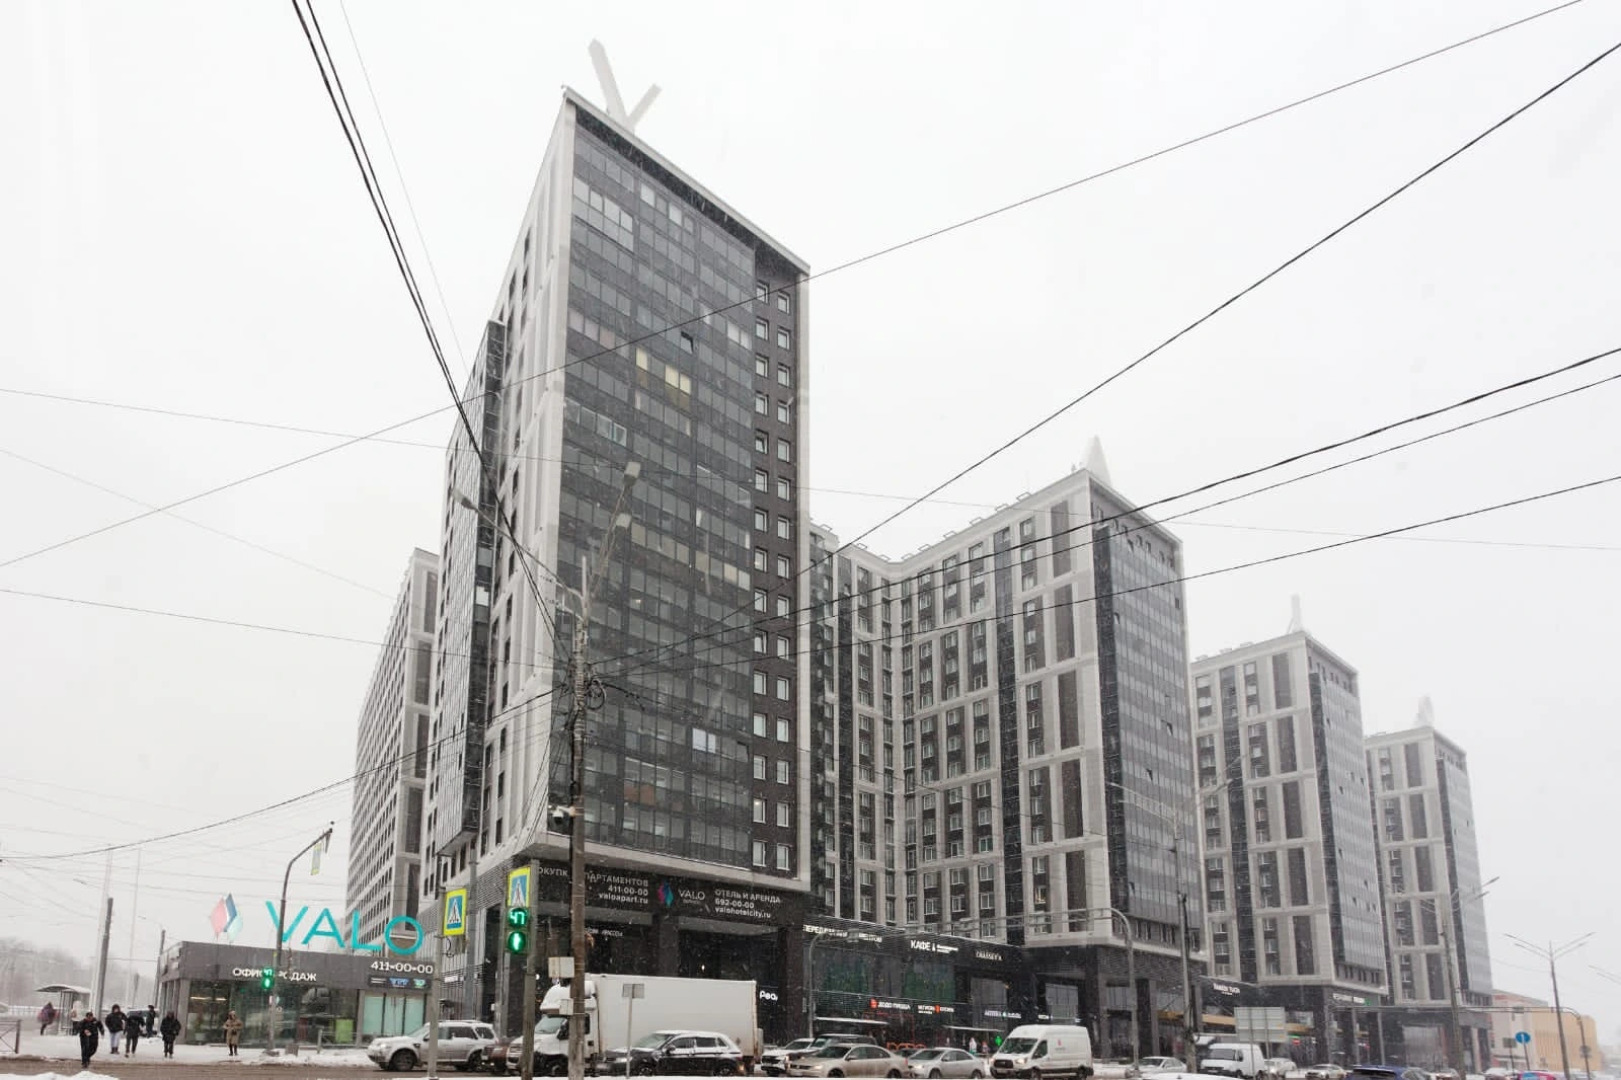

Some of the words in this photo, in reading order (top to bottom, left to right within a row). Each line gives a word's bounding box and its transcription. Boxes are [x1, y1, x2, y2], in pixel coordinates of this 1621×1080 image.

[584, 872, 649, 887] ПАРТАМЕНТОВ
[607, 884, 649, 897] 411-00-00
[678, 889, 706, 901] VALO
[265, 900, 424, 956] VALO
[910, 940, 931, 951] КАФЕ
[371, 961, 434, 974] 411-00-00
